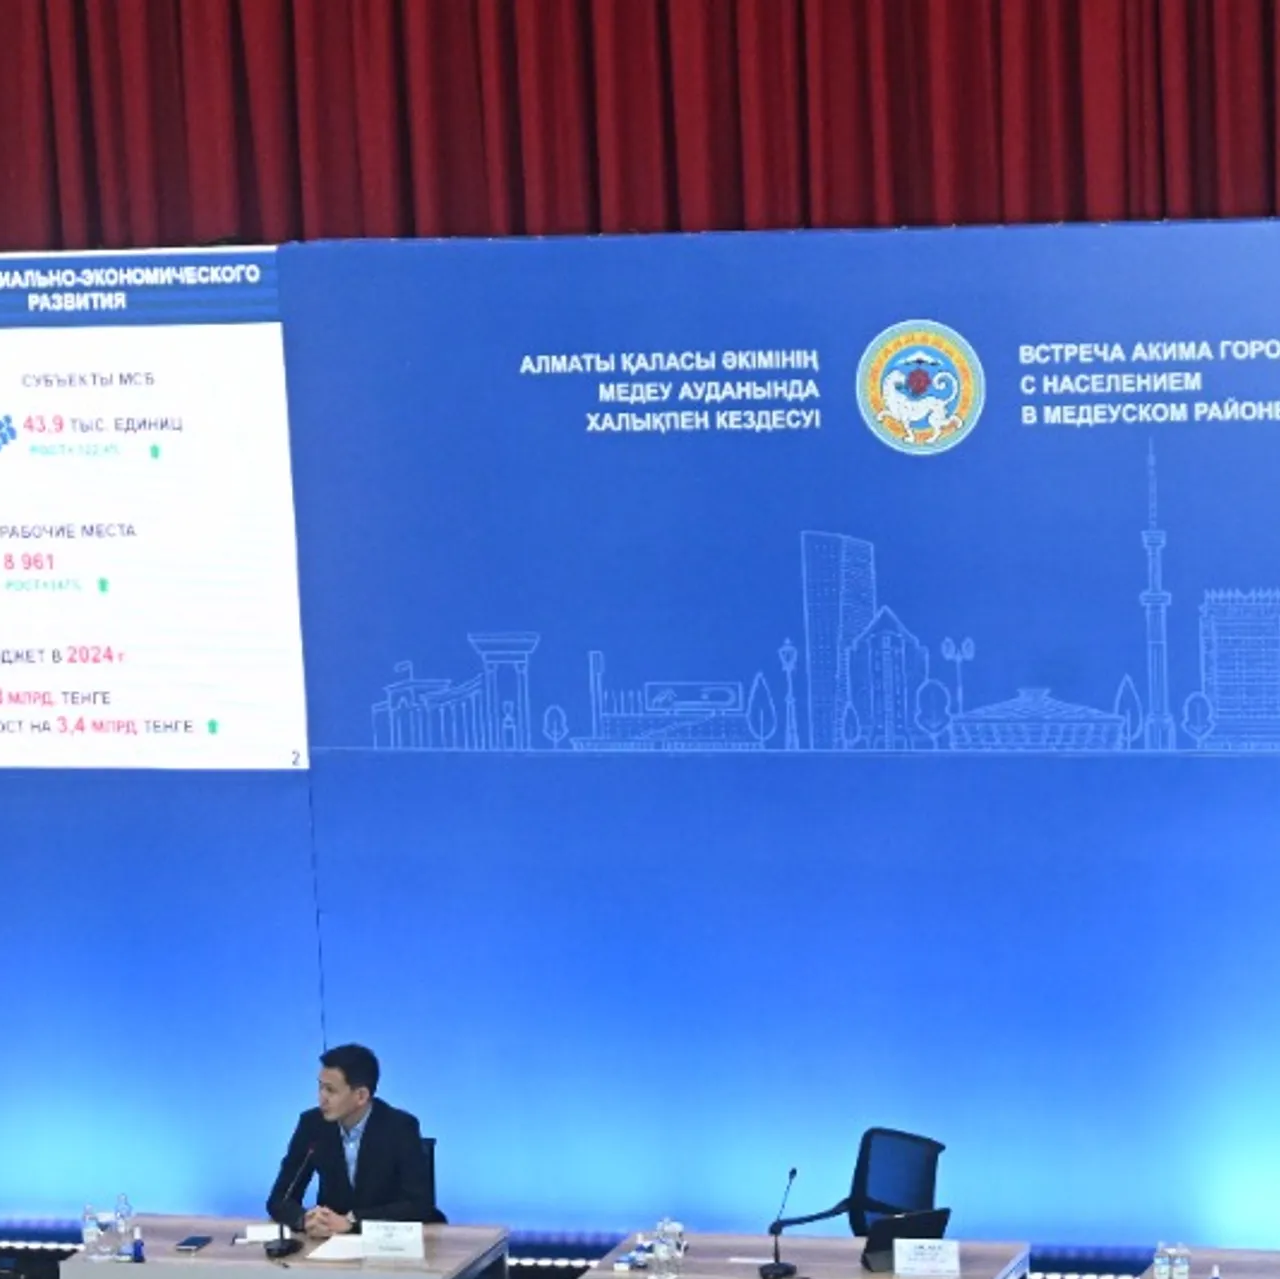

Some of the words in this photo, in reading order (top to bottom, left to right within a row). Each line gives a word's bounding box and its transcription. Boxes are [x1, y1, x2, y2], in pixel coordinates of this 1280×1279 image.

[28, 292, 126, 313] РАЗВИТИЯ
[520, 353, 615, 375] АЛМАТЫ
[621, 350, 716, 376] ҚАЛАСЫ
[721, 348, 819, 374] ӘКІМІНІҢ
[1019, 342, 1125, 364] ВСТРЕЧА
[1131, 340, 1213, 362] АКИМА
[22, 371, 113, 388] СУБЪЕКТЫ
[119, 370, 155, 386] МСБ
[1020, 374, 1036, 395] С
[1042, 371, 1202, 395] НАСЕЛЕНИЕМ
[598, 382, 672, 404] МЕДЕУ
[678, 379, 821, 403] АУДАНЫНДА
[113, 416, 183, 434] ЕДИНИЦ
[586, 410, 709, 435] ХАЛЫҚПЕН
[715, 408, 821, 433] КЕЗДЕСУІ
[1022, 405, 1036, 425] В
[1043, 402, 1187, 427] МЕДЕУСКОМ
[81, 521, 137, 538] МЕСТА
[3, 552, 15, 571] 8
[21, 552, 54, 571] 961
[52, 648, 63, 664] В
[67, 645, 114, 664] 2024
[61, 690, 111, 706] ТЕНГЕ
[30, 719, 51, 734] НА
[57, 715, 85, 737] 3,4
[144, 719, 193, 734] ТЕНГЕ
[290, 750, 301, 767] 2
